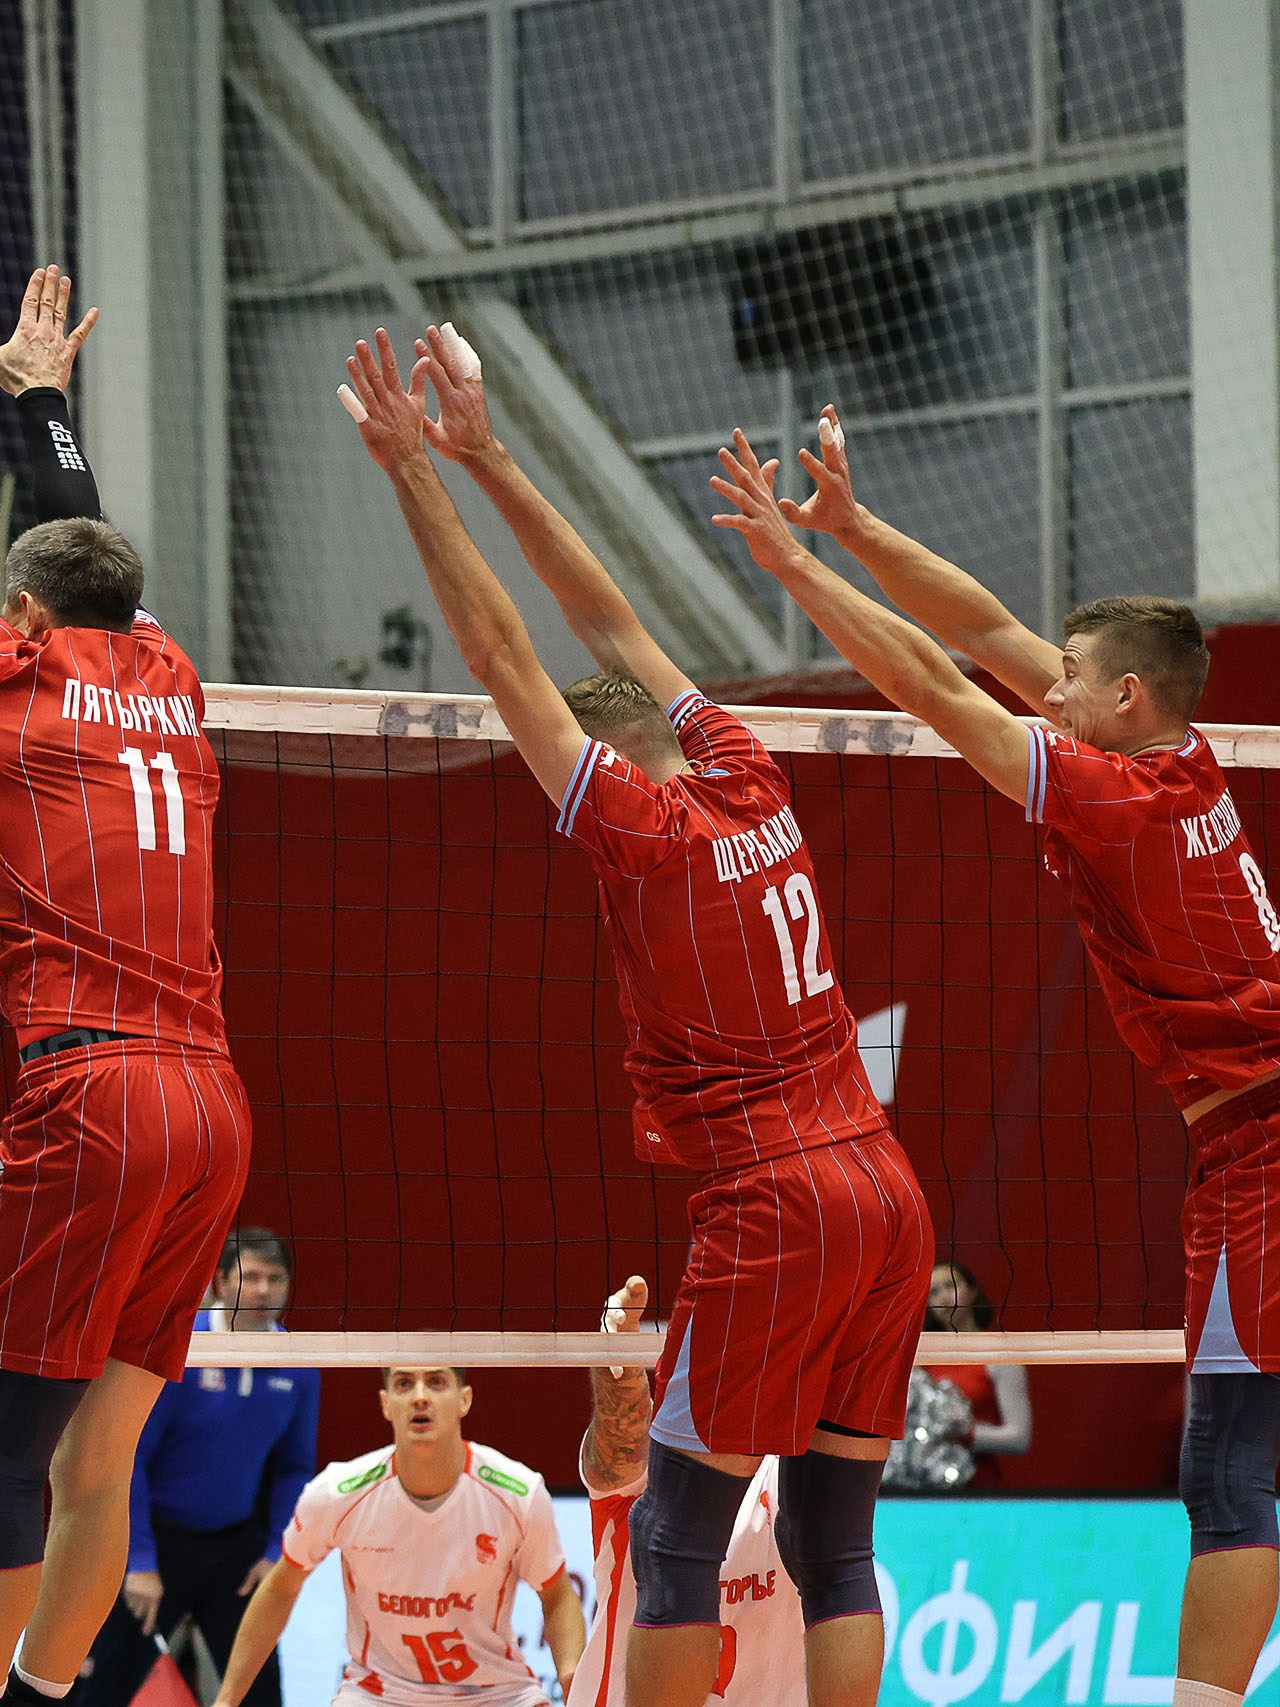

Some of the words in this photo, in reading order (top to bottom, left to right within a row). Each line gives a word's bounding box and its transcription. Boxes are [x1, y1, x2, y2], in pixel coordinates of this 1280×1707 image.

[62, 678, 200, 737] ПЯТЫРКИН
[118, 747, 186, 856] 11
[761, 873, 834, 1006] 12
[1239, 852, 1280, 953] 8
[402, 1628, 479, 1684] 15
